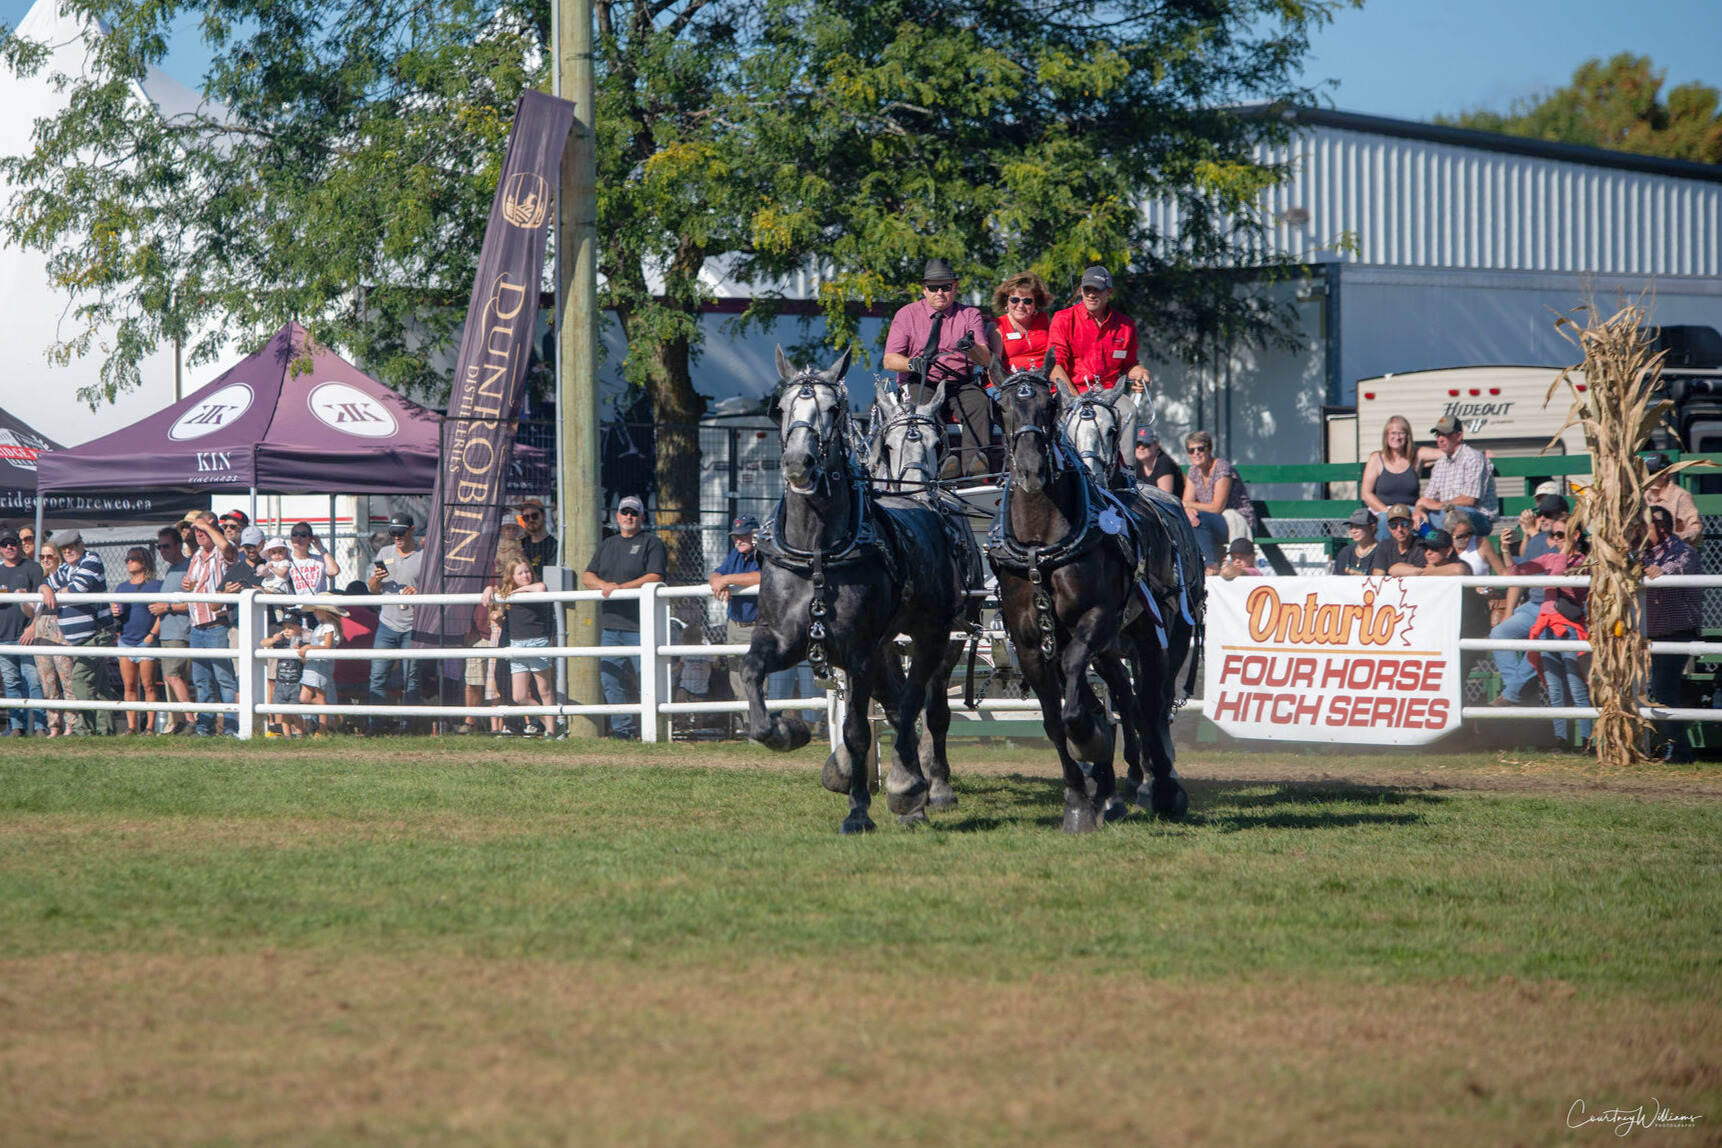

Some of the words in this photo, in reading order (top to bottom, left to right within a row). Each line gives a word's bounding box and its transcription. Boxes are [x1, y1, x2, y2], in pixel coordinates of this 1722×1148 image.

[444, 276, 527, 566] DUNROBIN
[449, 365, 480, 473] DISTILLERIES
[188, 475, 238, 483] VINEYARDS
[196, 451, 232, 472] KIN
[1246, 585, 1404, 646] Ontario
[1219, 654, 1318, 688] FOUR
[1320, 658, 1447, 692] HORSE
[1213, 691, 1324, 725] HITCH
[1325, 695, 1450, 730] SERIES
